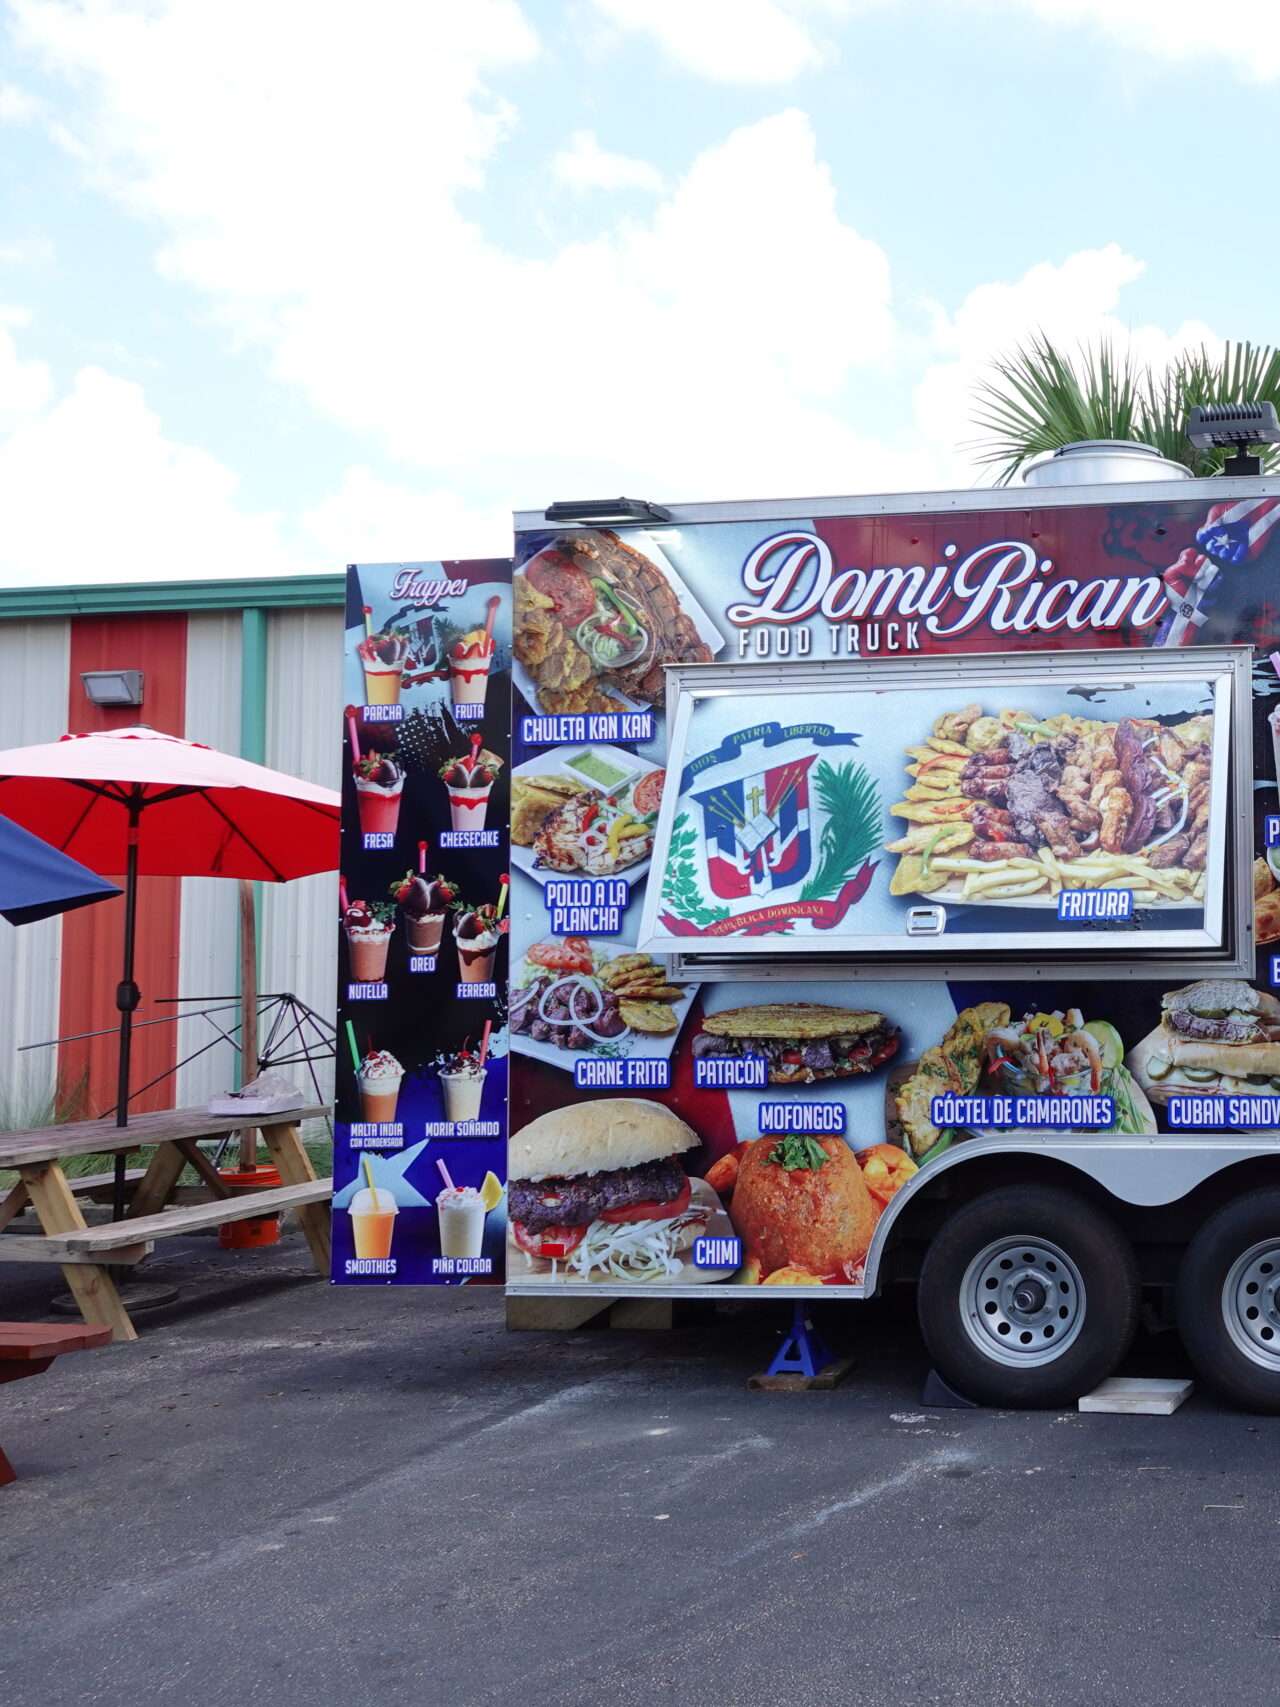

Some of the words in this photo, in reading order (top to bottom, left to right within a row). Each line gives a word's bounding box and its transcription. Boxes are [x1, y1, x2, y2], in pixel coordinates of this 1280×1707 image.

[390, 567, 468, 606] Frappes
[738, 626, 810, 657] FOOD
[829, 621, 921, 654] TRUCK
[363, 705, 402, 722] PARCHA
[455, 704, 484, 720] FRUTA
[523, 716, 585, 742] CHULETA
[589, 714, 619, 740] KAN
[621, 713, 651, 739] KAN
[732, 725, 773, 744] PATRIA
[783, 724, 831, 738] LIBERTAD
[364, 833, 394, 849] FRESA
[440, 831, 499, 848] CHEESECAKE
[547, 884, 593, 907] POLLO
[595, 883, 605, 907] A
[608, 882, 626, 905] LA
[1061, 892, 1129, 916] FRITURA
[554, 908, 619, 931] PLANCHA
[410, 957, 436, 972] OREO
[349, 984, 388, 999] NUTELLA
[457, 983, 496, 998] FERRERO
[577, 1062, 624, 1085] CARNE
[628, 1061, 668, 1084] FRITA
[697, 1056, 765, 1085] PATACÓN
[761, 1104, 843, 1130] MOFONGOS
[933, 1093, 989, 1123] CÓCTEL
[993, 1098, 1012, 1122] DE
[1016, 1097, 1112, 1124] CAMARONES
[1171, 1099, 1225, 1124] CUBAN
[351, 1123, 377, 1136] MALTA
[379, 1123, 403, 1136] INDIA
[425, 1122, 454, 1137] MORIR
[456, 1120, 500, 1137] SOÑANDO
[696, 1239, 739, 1265] CHIMI
[345, 1259, 397, 1275] SMOOTHIES
[432, 1257, 455, 1274] PIÑA
[456, 1258, 492, 1274] COLADA
